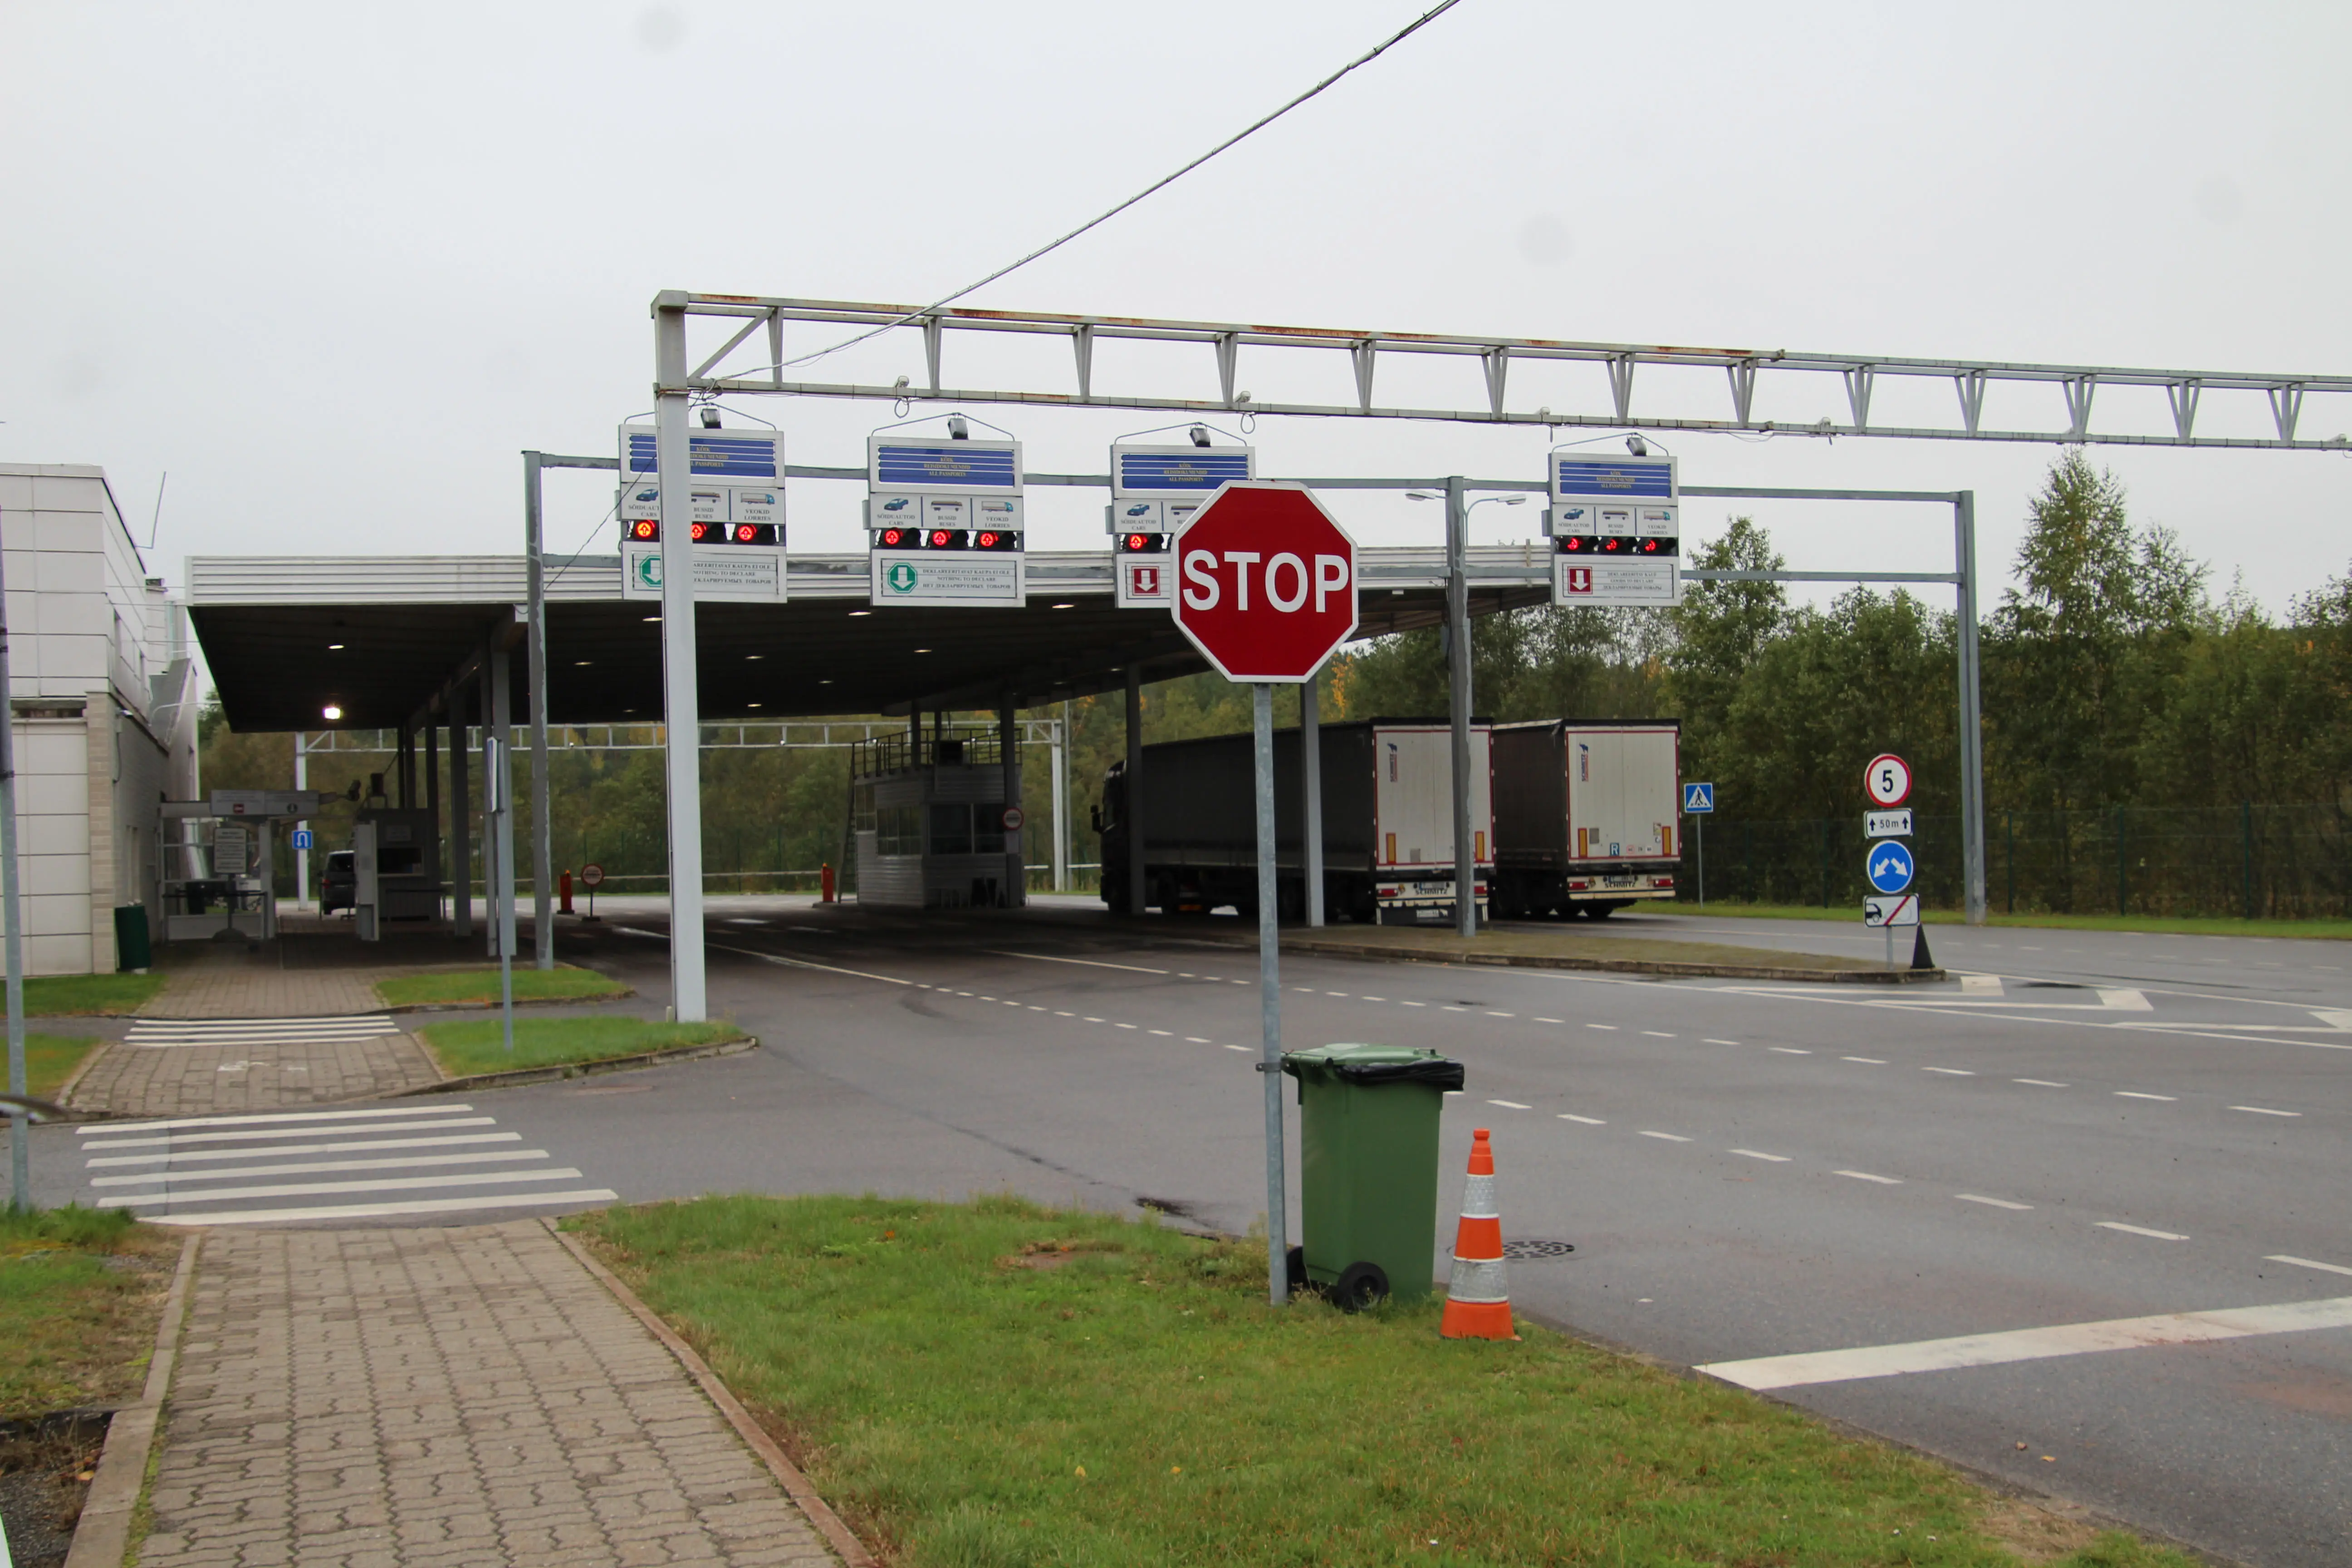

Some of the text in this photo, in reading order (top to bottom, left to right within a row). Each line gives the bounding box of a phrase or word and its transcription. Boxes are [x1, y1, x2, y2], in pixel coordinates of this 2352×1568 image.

[1183, 549, 1349, 613] STOP
[1882, 769, 1893, 793] 5
[1880, 819, 1899, 828] 50m
[1612, 844, 1618, 855] R
